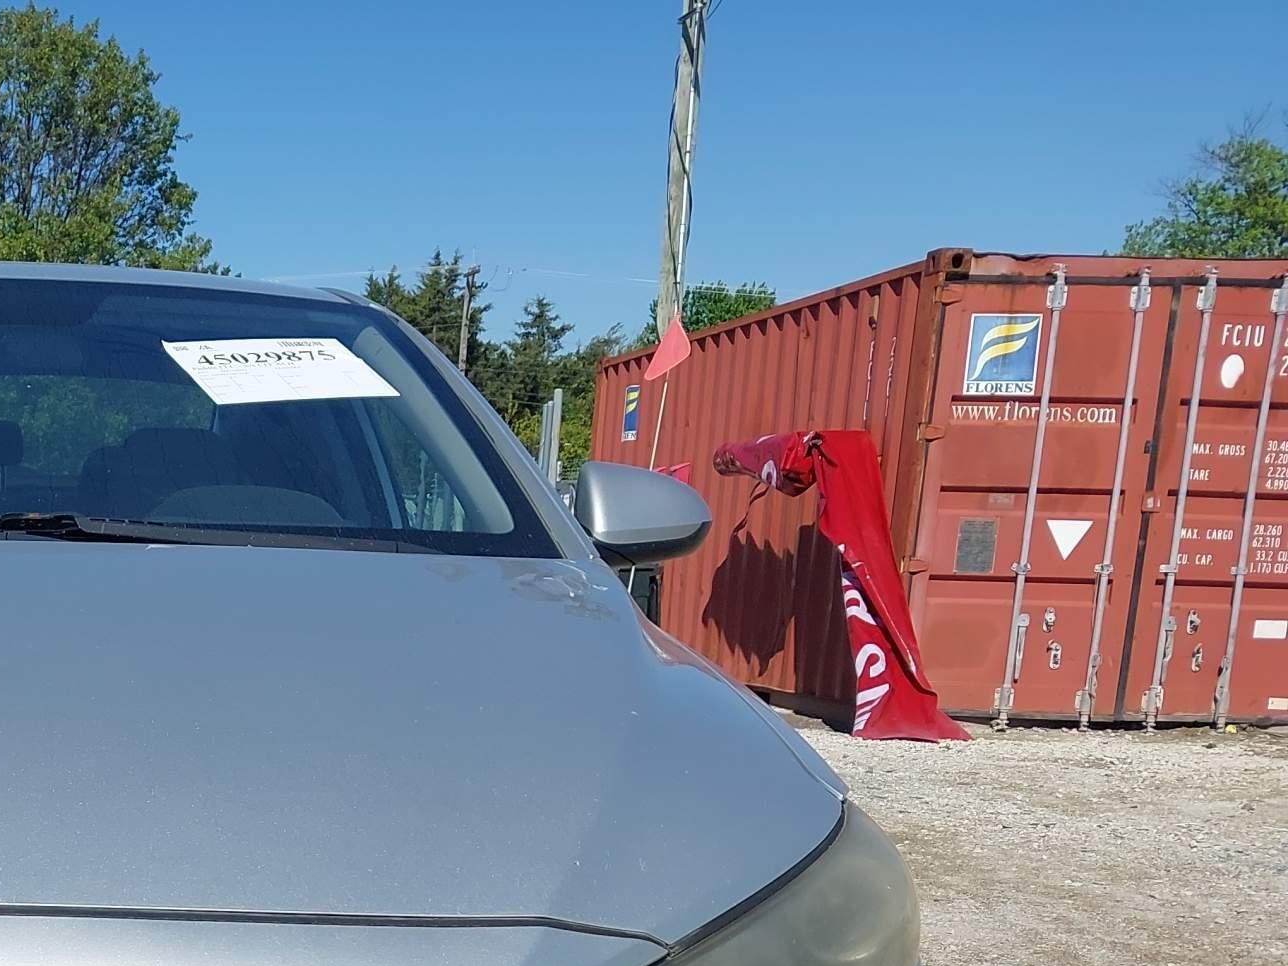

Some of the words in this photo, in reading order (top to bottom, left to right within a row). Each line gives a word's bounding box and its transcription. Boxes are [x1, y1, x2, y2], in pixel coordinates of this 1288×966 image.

[1221, 323, 1265, 347] FCIU
[198, 350, 336, 366] 45029875
[965, 382, 1033, 393] FLORENS
[1192, 443, 1214, 455] MAX.
[1218, 444, 1246, 456] GROSS
[1189, 469, 1211, 481] TARE
[1181, 528, 1201, 539] MAX.
[1206, 529, 1233, 540] CARGO
[1252, 537, 1281, 548] 62.310
[1195, 554, 1214, 566] CAP.
